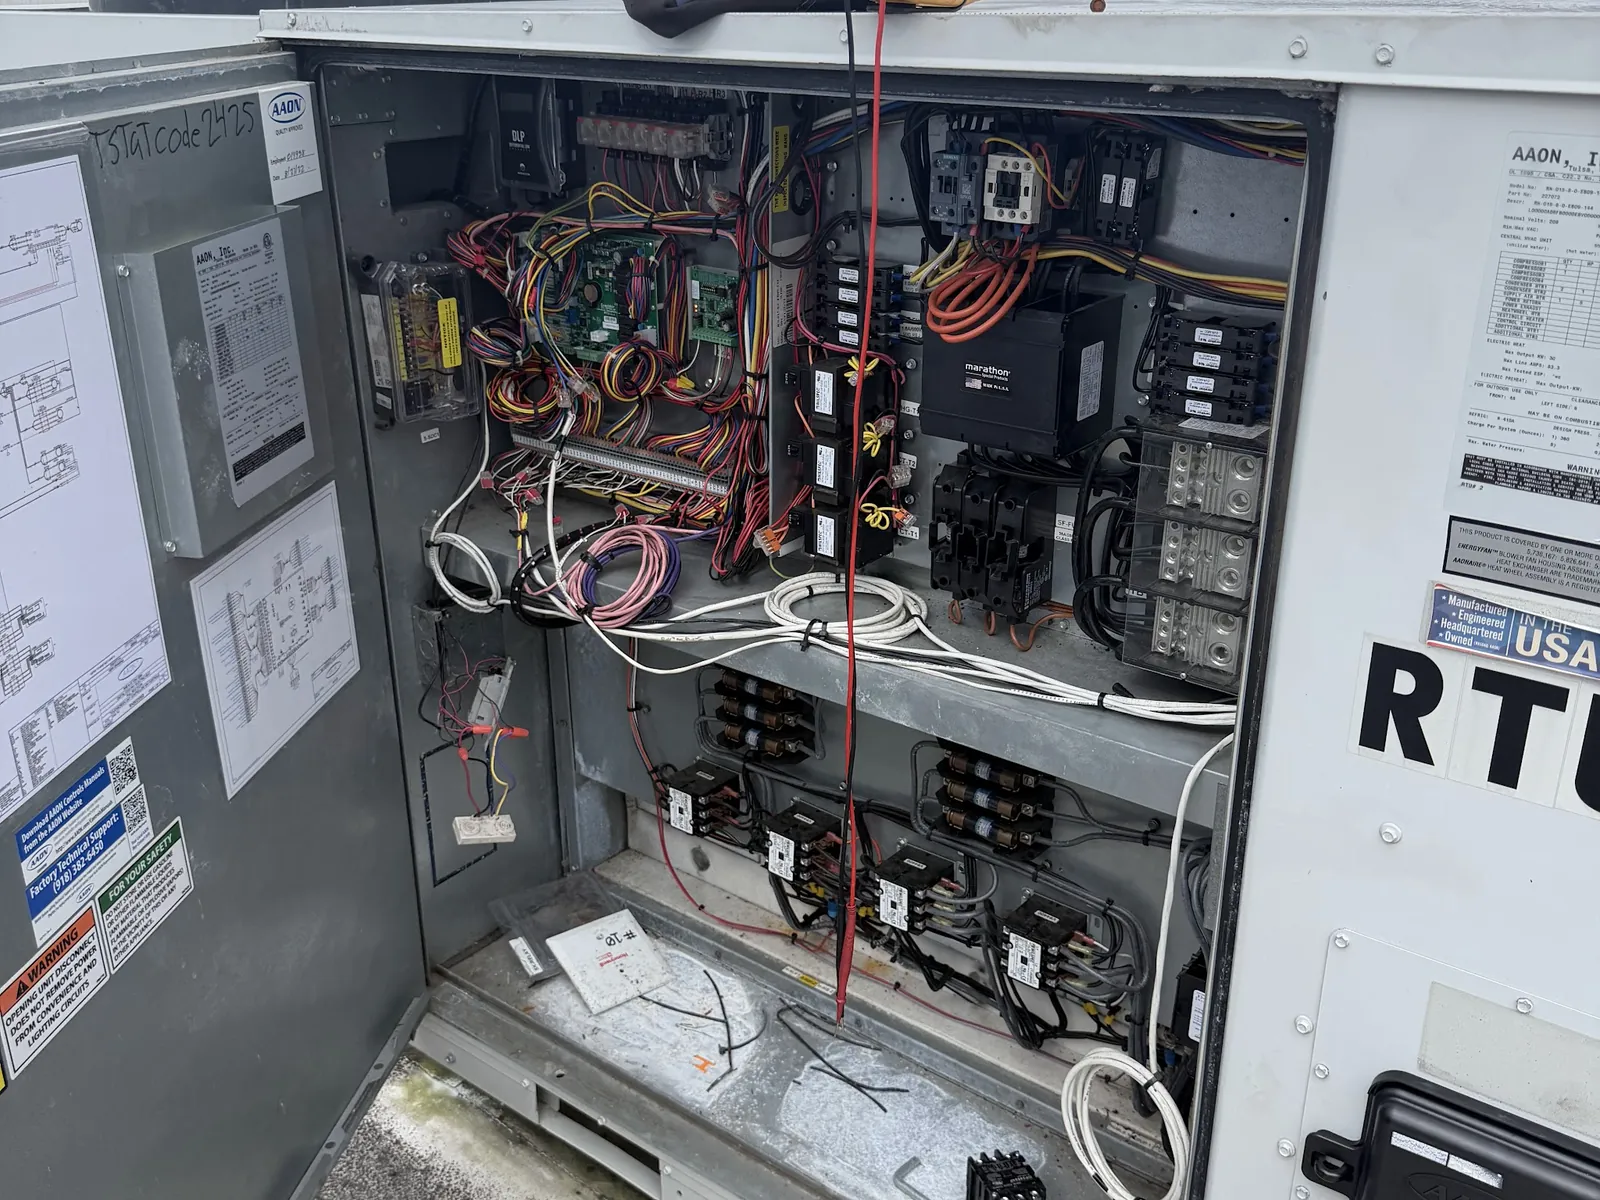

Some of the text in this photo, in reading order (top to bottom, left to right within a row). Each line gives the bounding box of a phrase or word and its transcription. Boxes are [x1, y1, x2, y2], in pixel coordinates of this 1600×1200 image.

[270, 98, 302, 116] AAON
[511, 129, 526, 143] DLP
[1512, 145, 1600, 167] AAON, I
[965, 363, 1010, 376] marathon
[1481, 372, 1503, 380] ELECTRIC
[1486, 384, 1510, 392] OUTDOOR
[1566, 416, 1600, 426] COMBUSTIB
[1567, 463, 1600, 476] WARNIN
[1474, 530, 1502, 541] PRODUCT
[1511, 537, 1539, 548] COVERED
[1550, 545, 1562, 553] ONE
[1575, 550, 1594, 559] MORE
[1487, 564, 1502, 572] HEAT
[1504, 567, 1523, 577] WHEEL
[1525, 572, 1556, 584] ASSEMBLY
[1499, 550, 1526, 562] BLOWER
[1525, 556, 1537, 564] FAN
[1538, 558, 1566, 570] HOUSING
[1567, 564, 1600, 577] ASSEMBLY
[1512, 561, 1549, 574] EXCHANGER
[1550, 569, 1562, 577] ARE
[1448, 594, 1508, 617] Manufactured
[1458, 608, 1506, 629] Engineered
[1520, 612, 1572, 635] IN THE
[1440, 617, 1504, 641] Headquartered
[1444, 631, 1473, 646] Owned
[1515, 624, 1598, 672] USA
[1358, 641, 1600, 813] RT
[21, 765, 105, 843] Download AAON Controls Manuals
[23, 796, 83, 854] from the AAON Website
[29, 865, 58, 899] Factory
[56, 837, 90, 874] Technical
[89, 810, 119, 844] Support:
[30, 847, 49, 867] AAON
[51, 838, 104, 894] (918) 382-6450
[108, 879, 125, 902] FOR
[125, 858, 146, 886] YOUR
[145, 832, 172, 865] SAFETY
[113, 898, 124, 913] NOT
[122, 885, 136, 904] STORE
[144, 870, 152, 882] USE
[152, 849, 173, 874] GASOLINE
[114, 902, 129, 922] OTHER
[129, 876, 155, 906] FLAMMABLE
[155, 859, 172, 880] LIQUIDS
[120, 900, 141, 925] MATERIAL
[141, 889, 152, 904] THAT
[153, 866, 174, 892] PRODUCES
[110, 914, 136, 945] FLAMMABLE
[144, 885, 165, 911] EXPLOSIVE
[118, 934, 127, 948] THE
[126, 916, 144, 939] VICINITY
[151, 900, 160, 913] THIS
[167, 883, 176, 896] ANY
[27, 926, 78, 984] WARNING
[114, 916, 154, 961] OTHER APPLIANCE.
[4, 931, 95, 1028] OPENING UNIT DISCONNECT
[10, 944, 96, 1037] DOES NOT REMOVE POWER
[14, 956, 96, 1047] FROM CONVENIENCE AND
[27, 978, 89, 1048] LIGHTING CIRCUITS
